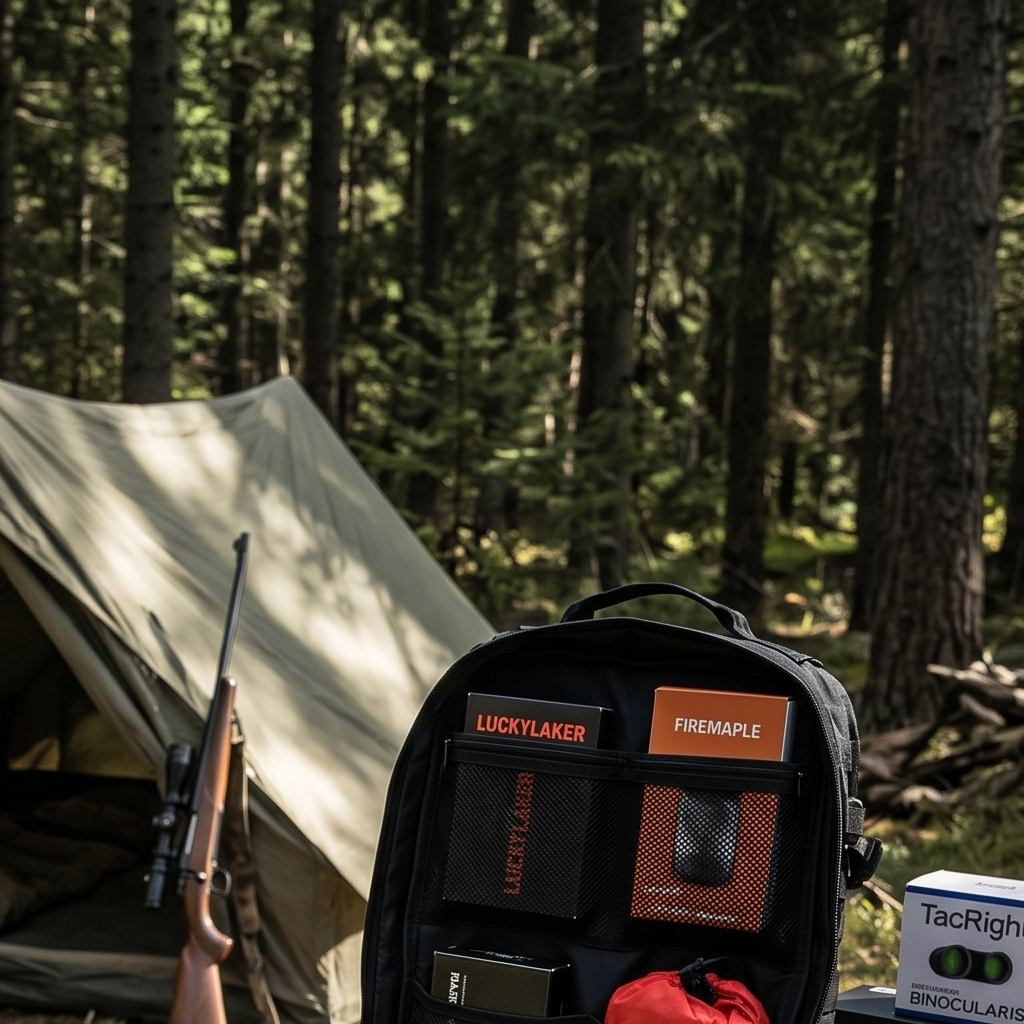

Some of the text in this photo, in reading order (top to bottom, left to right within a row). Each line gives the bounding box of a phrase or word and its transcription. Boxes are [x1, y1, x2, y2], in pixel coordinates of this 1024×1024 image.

[476, 714, 587, 743] LUCKYLAKER
[674, 717, 762, 739] FIREMAPLE
[920, 902, 1024, 941] TacRigh
